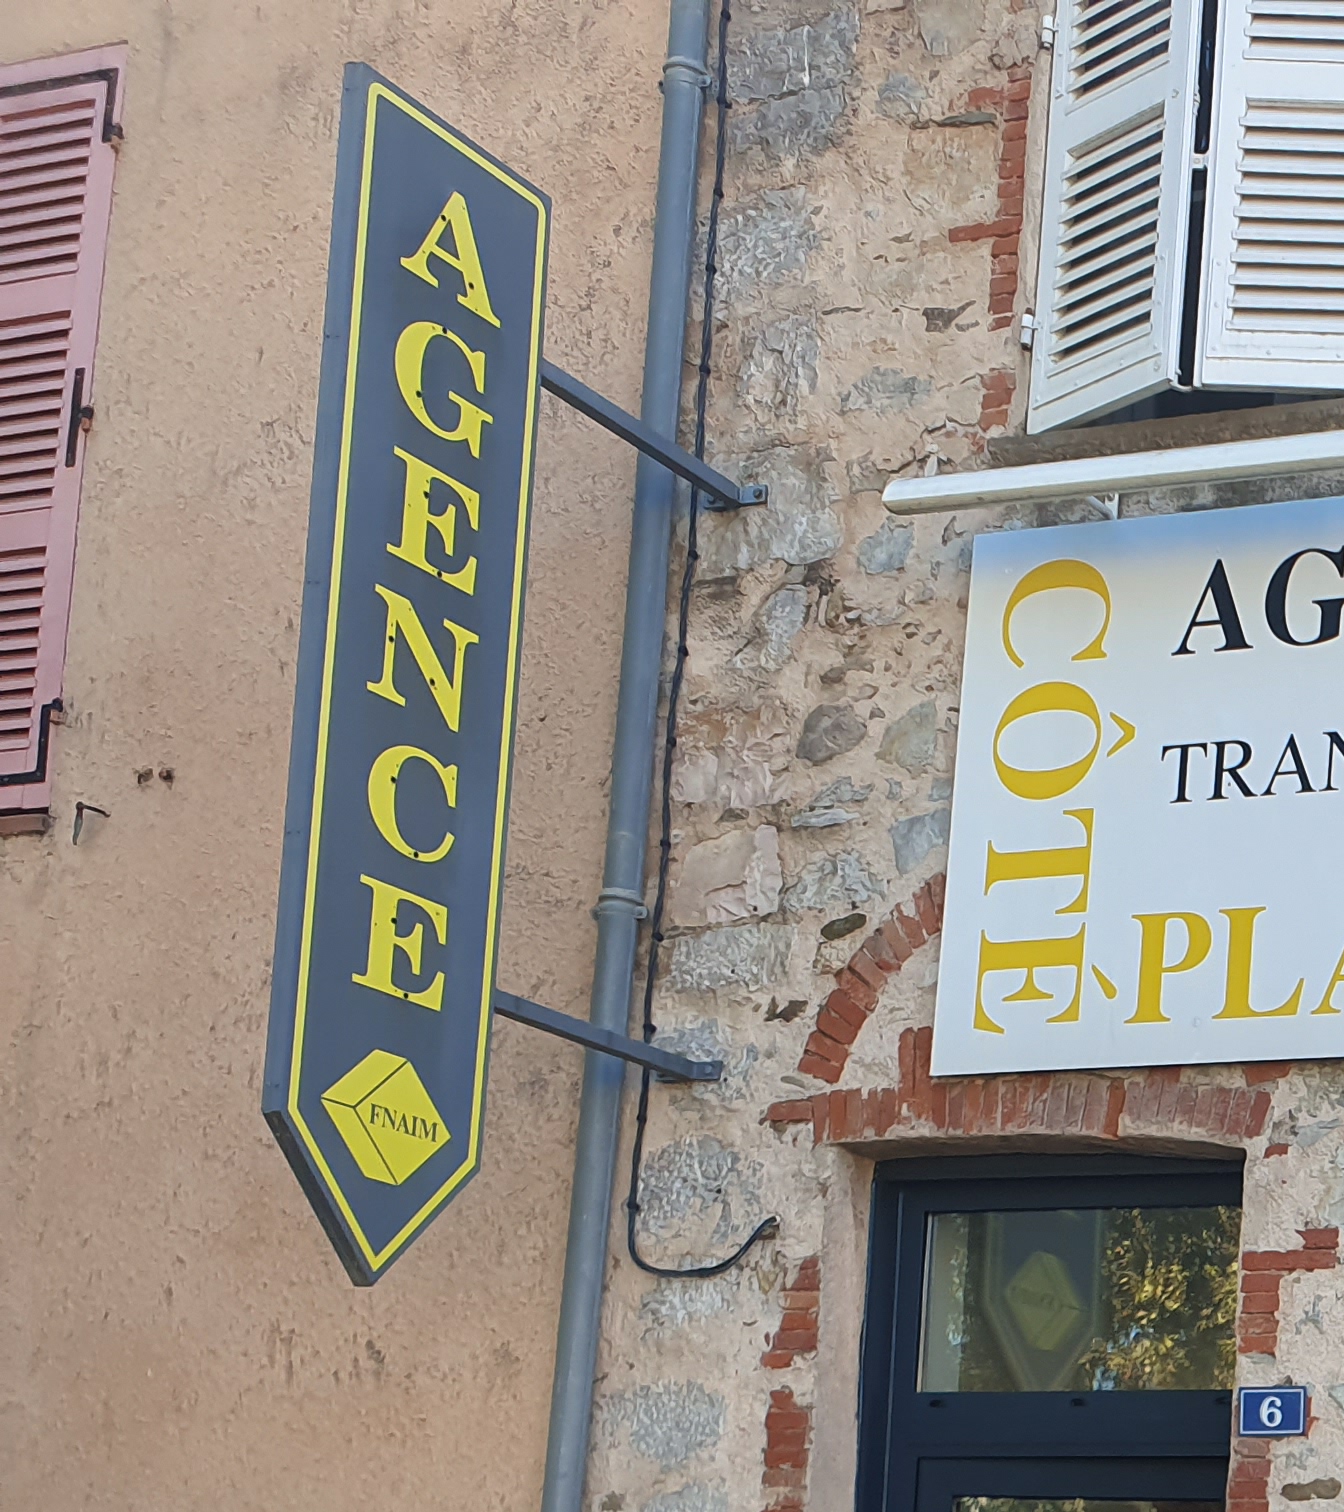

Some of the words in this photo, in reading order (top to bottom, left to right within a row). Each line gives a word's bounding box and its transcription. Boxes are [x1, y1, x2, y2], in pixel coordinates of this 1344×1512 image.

[351, 190, 501, 1012] AGENCE
[369, 1102, 439, 1143] FNAIM
[1259, 1395, 1283, 1428] 6
